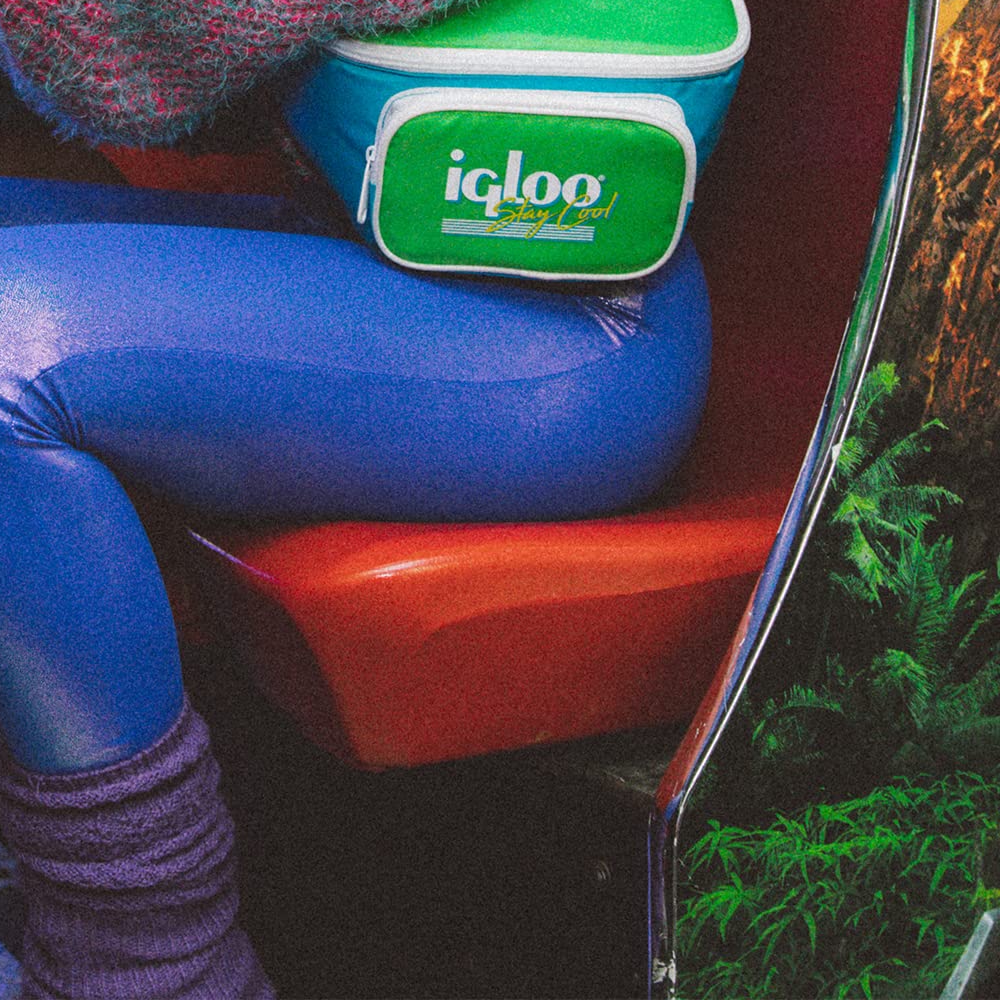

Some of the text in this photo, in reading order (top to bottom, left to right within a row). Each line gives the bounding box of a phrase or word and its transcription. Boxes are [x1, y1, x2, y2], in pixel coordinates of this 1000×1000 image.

[444, 148, 602, 218] igloo
[485, 191, 619, 239] Stay Cool
